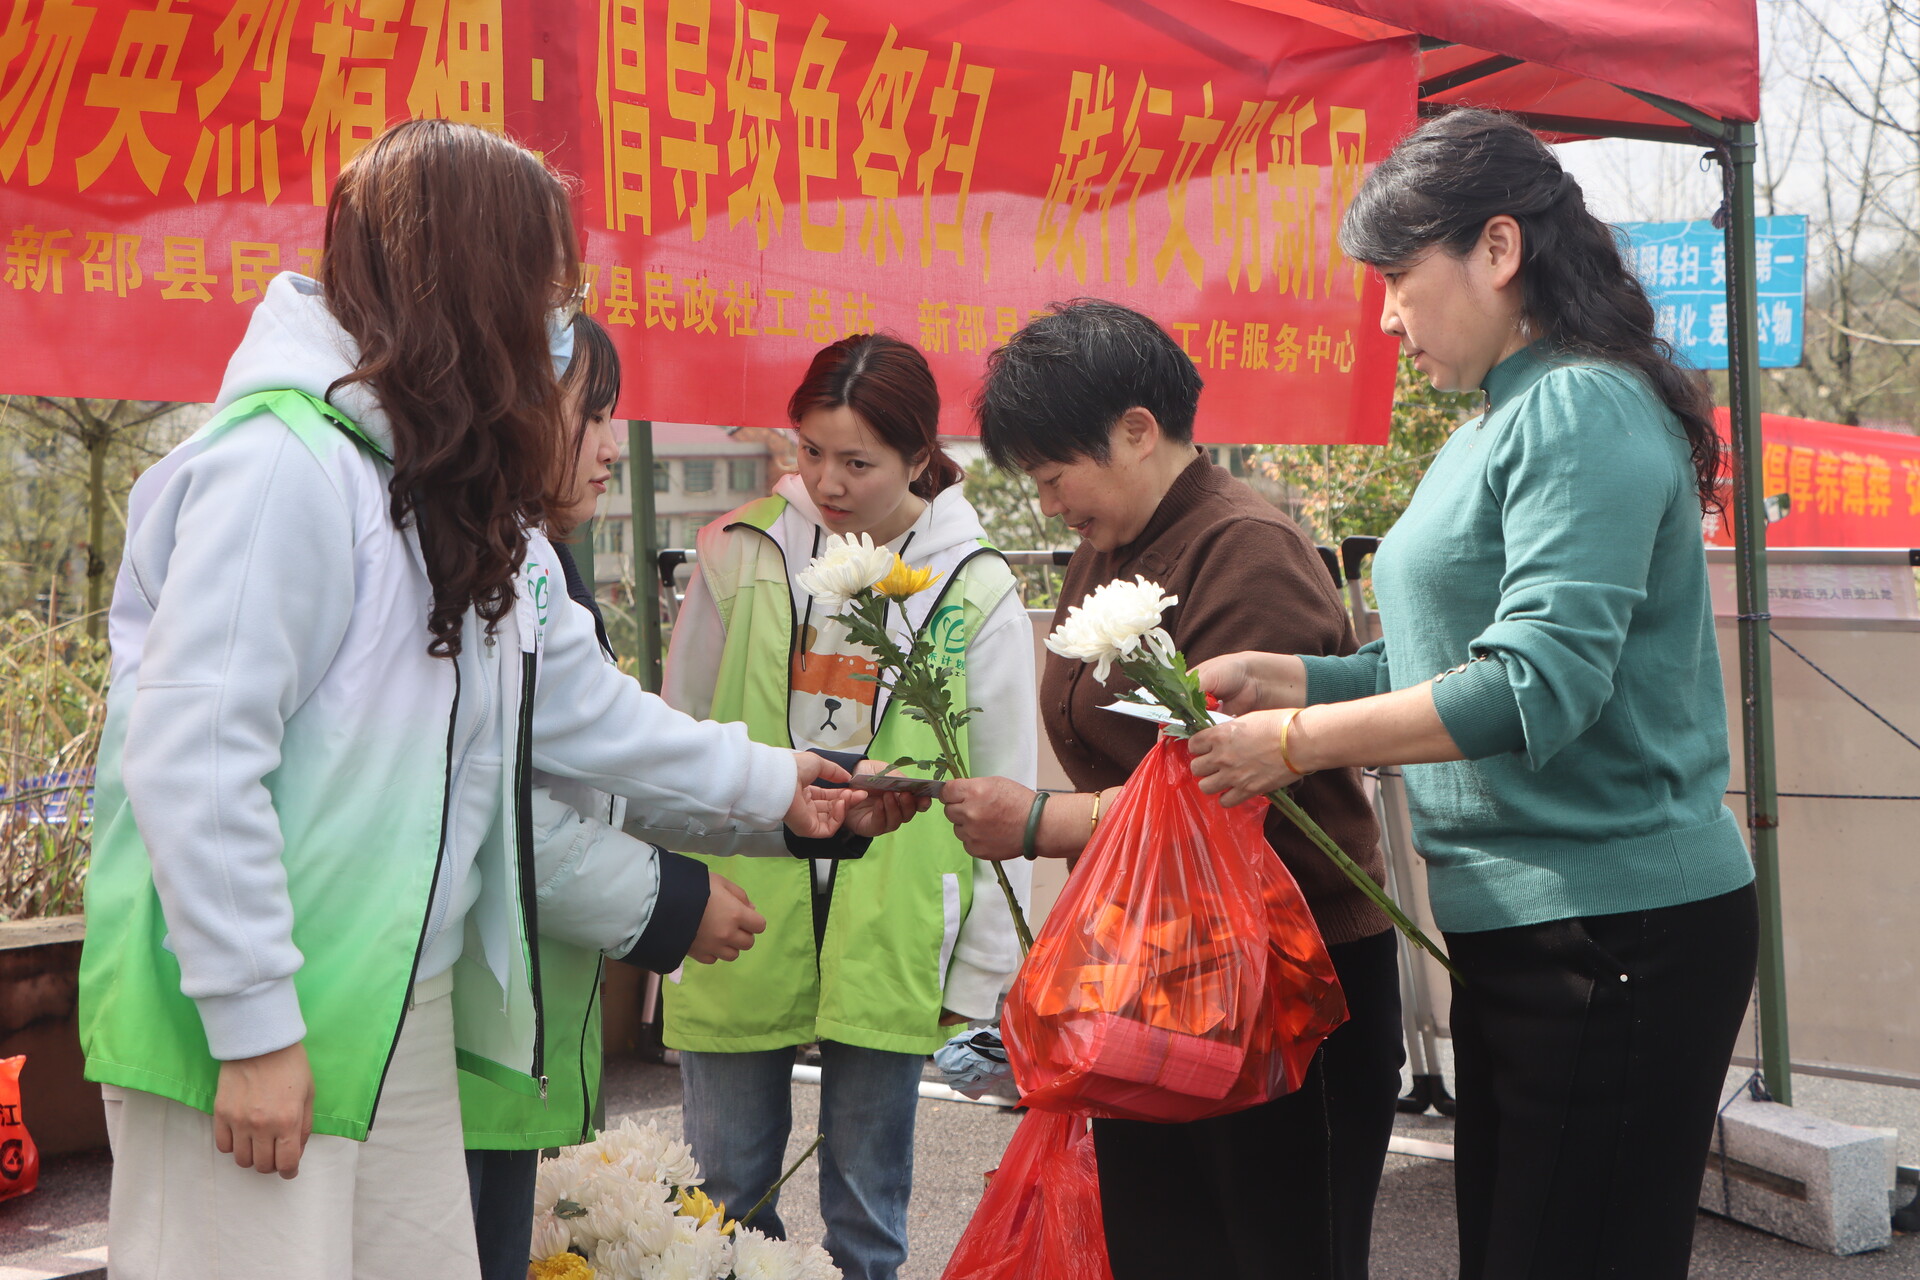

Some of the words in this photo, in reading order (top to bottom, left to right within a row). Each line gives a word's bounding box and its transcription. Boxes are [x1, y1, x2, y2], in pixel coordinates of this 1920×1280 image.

[1711, 238, 1796, 286] 安第一
[1708, 300, 1793, 347] 爱公物
